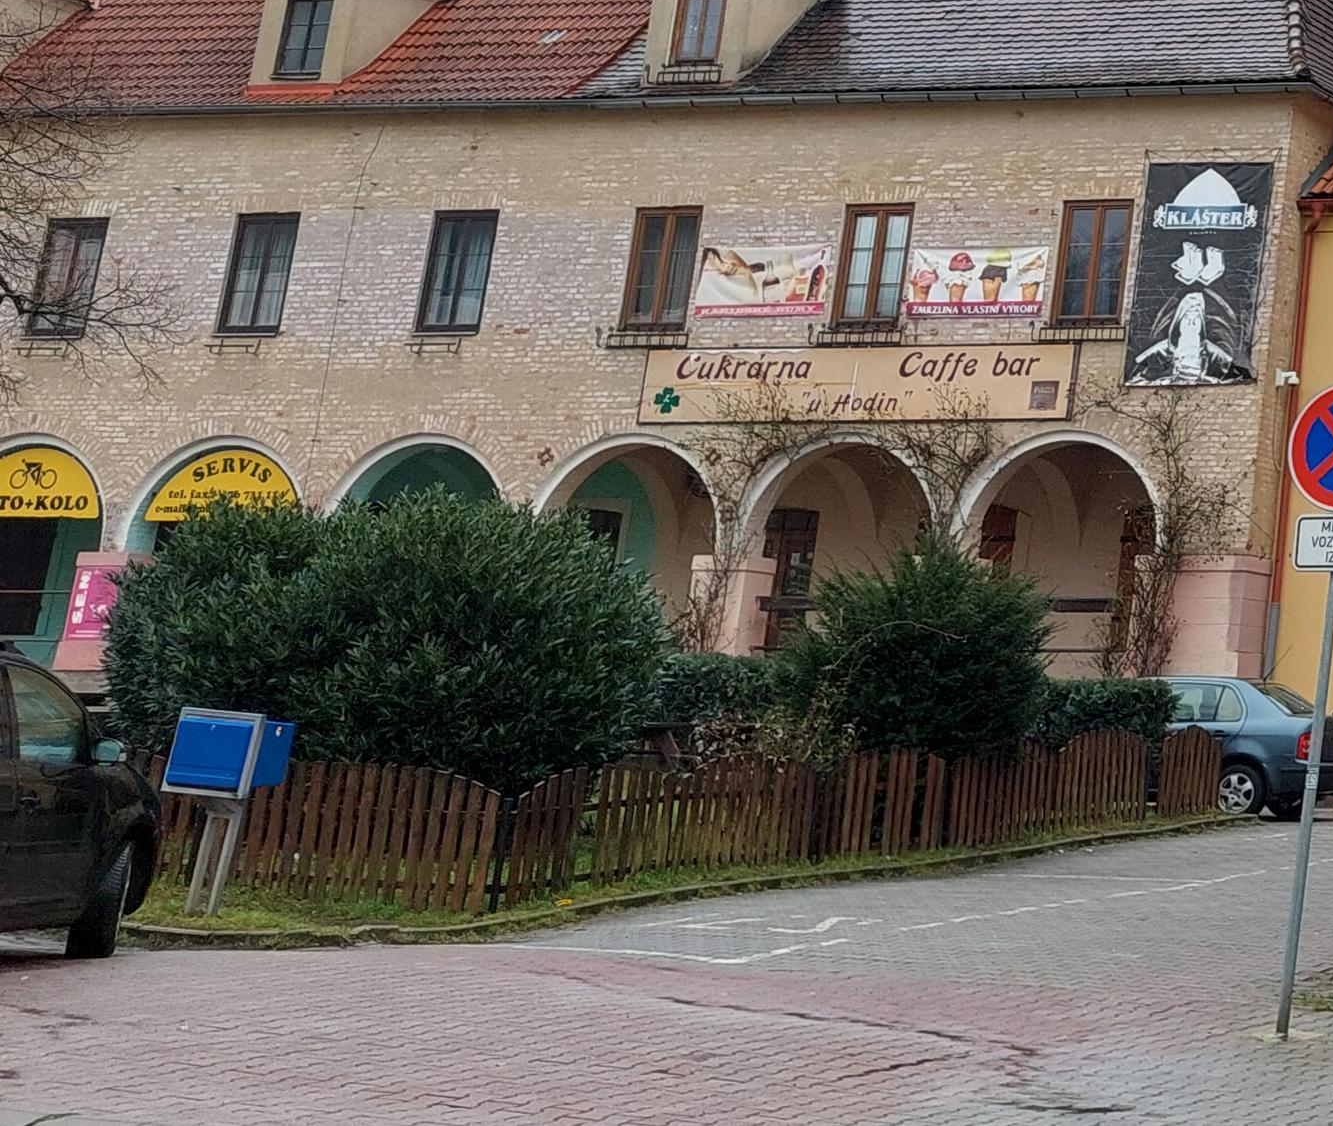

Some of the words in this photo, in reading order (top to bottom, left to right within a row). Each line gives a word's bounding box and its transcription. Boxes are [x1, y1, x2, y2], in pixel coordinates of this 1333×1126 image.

[1167, 208, 1243, 226] KLÁŠTER
[912, 305, 959, 315] ZMRZLINA
[962, 303, 1000, 315] VLASTNÍ
[1003, 303, 1040, 314] VÝROBY
[676, 351, 813, 381] Cukrárna
[899, 351, 977, 382] Caffe
[992, 351, 1041, 376] bar
[192, 457, 272, 483] SERVIS
[168, 490, 187, 499] tel.
